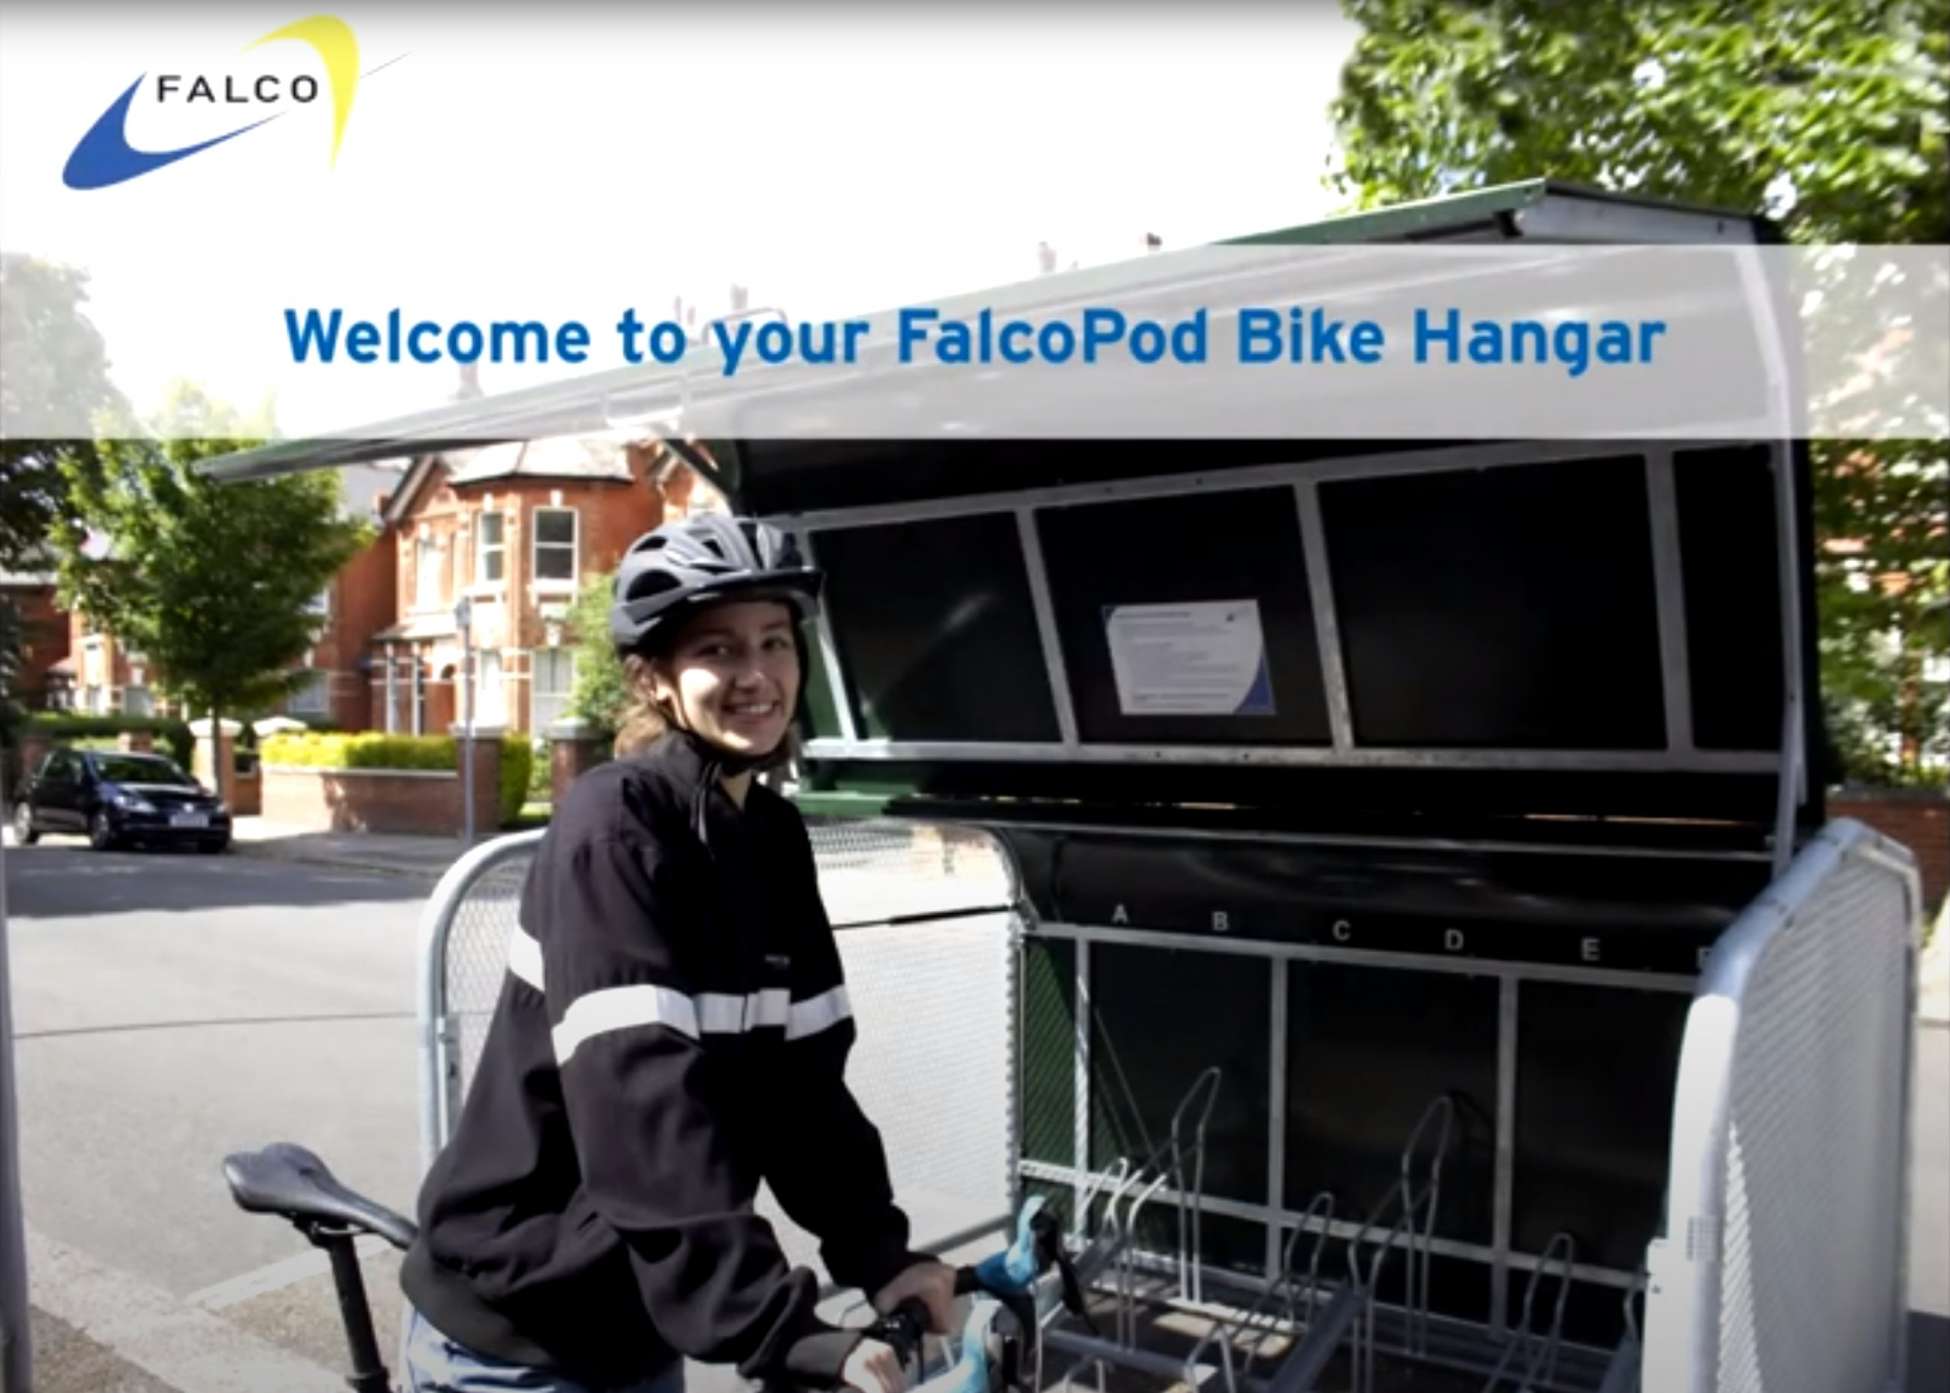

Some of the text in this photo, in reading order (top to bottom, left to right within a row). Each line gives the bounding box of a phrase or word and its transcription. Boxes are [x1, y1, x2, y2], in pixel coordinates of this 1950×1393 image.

[1112, 904, 1129, 923] A
[1212, 911, 1228, 931] B
[1333, 919, 1350, 941] C
[1445, 929, 1463, 950] D
[1581, 938, 1599, 961] E
